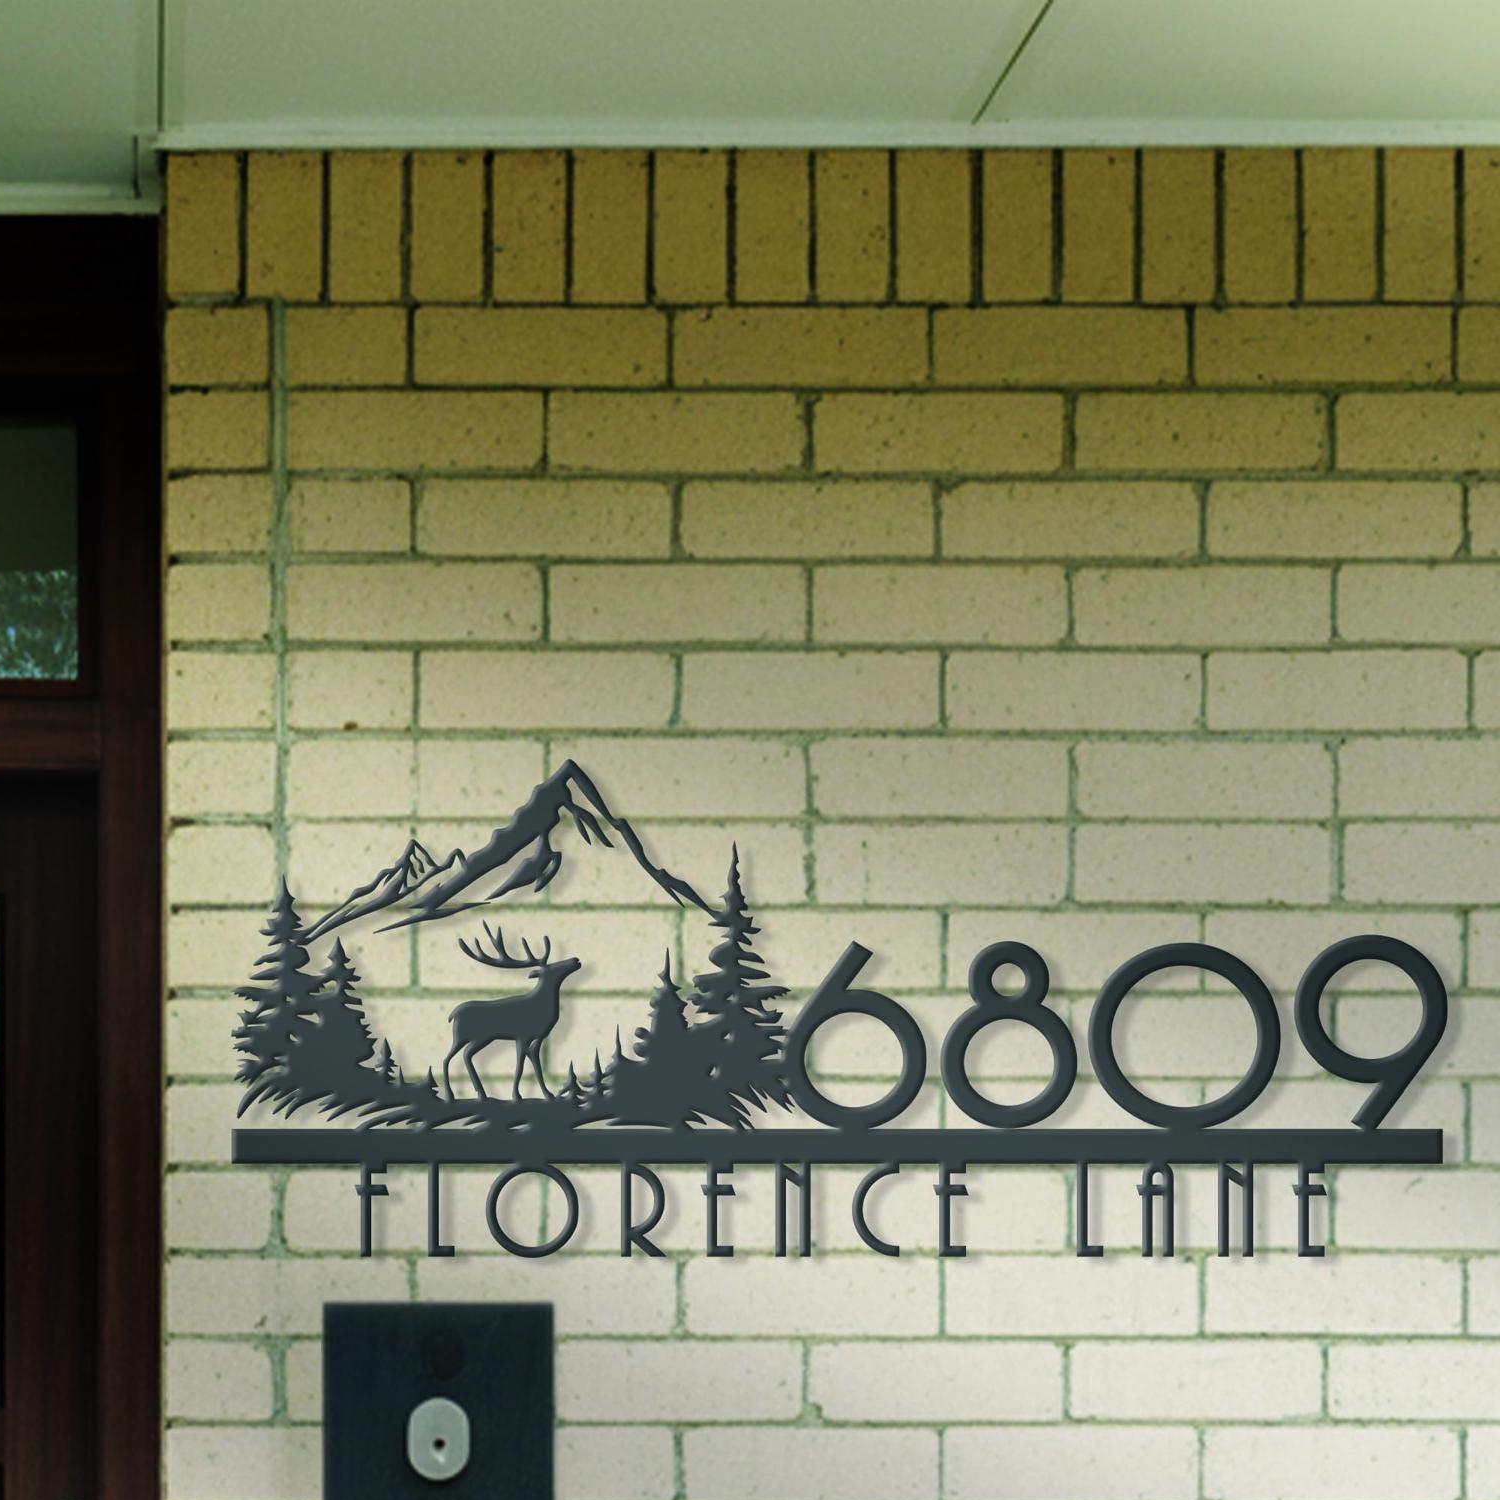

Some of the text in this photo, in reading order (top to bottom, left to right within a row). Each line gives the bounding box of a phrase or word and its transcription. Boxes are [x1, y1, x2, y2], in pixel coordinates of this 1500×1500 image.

[783, 934, 1448, 1130] 6809
[353, 1163, 1328, 1258] FLORENCE LANE
